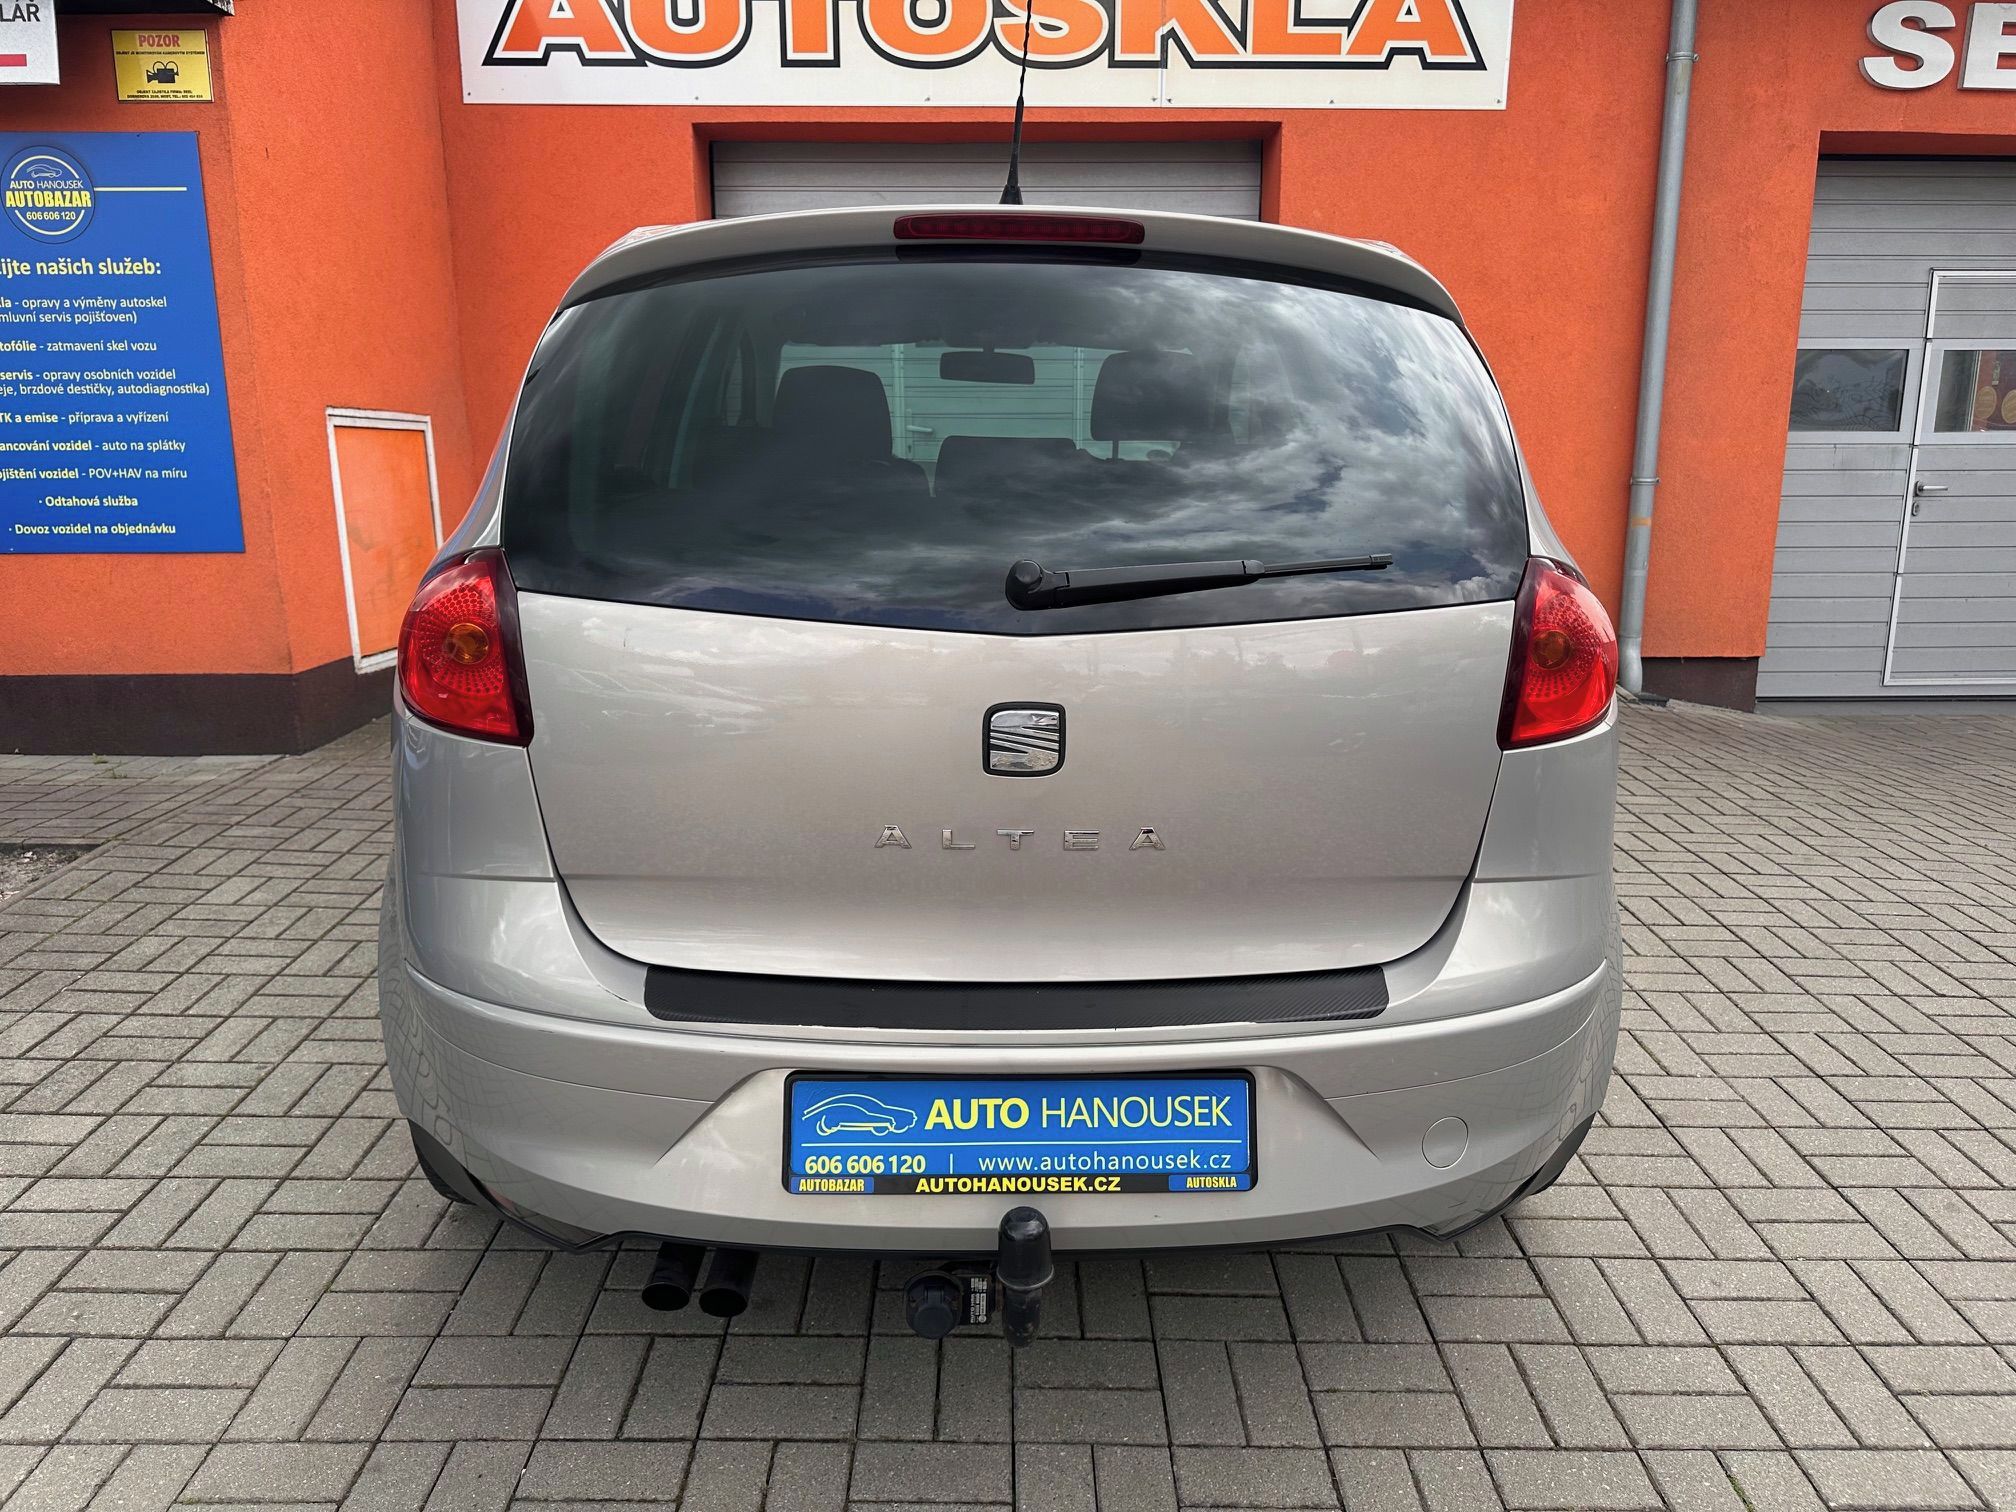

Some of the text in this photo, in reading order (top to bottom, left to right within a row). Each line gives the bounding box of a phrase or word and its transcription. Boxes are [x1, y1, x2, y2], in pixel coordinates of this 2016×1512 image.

[138, 34, 181, 48] POZOR
[482, 0, 1487, 69] AUTOSKLA
[10, 180, 84, 189] AUTO HANOUSEK
[5, 190, 92, 208] AUTOBAZAR
[26, 211, 76, 221] 606 606 120
[0, 257, 161, 278] ijte našich služeb:
[22, 299, 60, 310] opravy
[63, 299, 71, 308] a
[73, 296, 117, 310] výměny
[121, 296, 167, 308] autoskel
[39, 311, 72, 323] servis
[75, 310, 137, 324] pojišťoven)
[47, 340, 104, 352] zatmavení
[107, 340, 128, 352] skel
[131, 342, 157, 352] vozu
[0, 368, 176, 382] servis opravy osobních vozidel
[20, 383, 64, 395] brzdové
[67, 382, 115, 397] destičky,
[117, 382, 210, 396] autodiagnostika)
[15, 414, 22, 423] a
[25, 412, 59, 423] emise
[68, 411, 114, 425] příprava
[116, 414, 124, 423] a
[126, 411, 169, 425] vyřízení
[52, 439, 92, 451] vozidel
[102, 441, 127, 451] auto
[130, 442, 144, 451] na
[147, 439, 186, 453] splátky
[39, 467, 79, 479] vozidel
[89, 468, 142, 479] POV+HAV
[145, 470, 158, 479] na
[161, 467, 188, 479] míru
[45, 496, 138, 507] Odtahová služba
[15, 523, 176, 536] Dovoz vozidel na objednávku
[873, 824, 1167, 850] ALTEA
[924, 1095, 1233, 1131] AUTO HANOUSEK
[804, 1149, 1232, 1175] 606 606 120 www.autohanousek.cz
[798, 1176, 1237, 1193] AUTOBAZAR AUTOHANOUSEK.CZ AUTOSKLA
